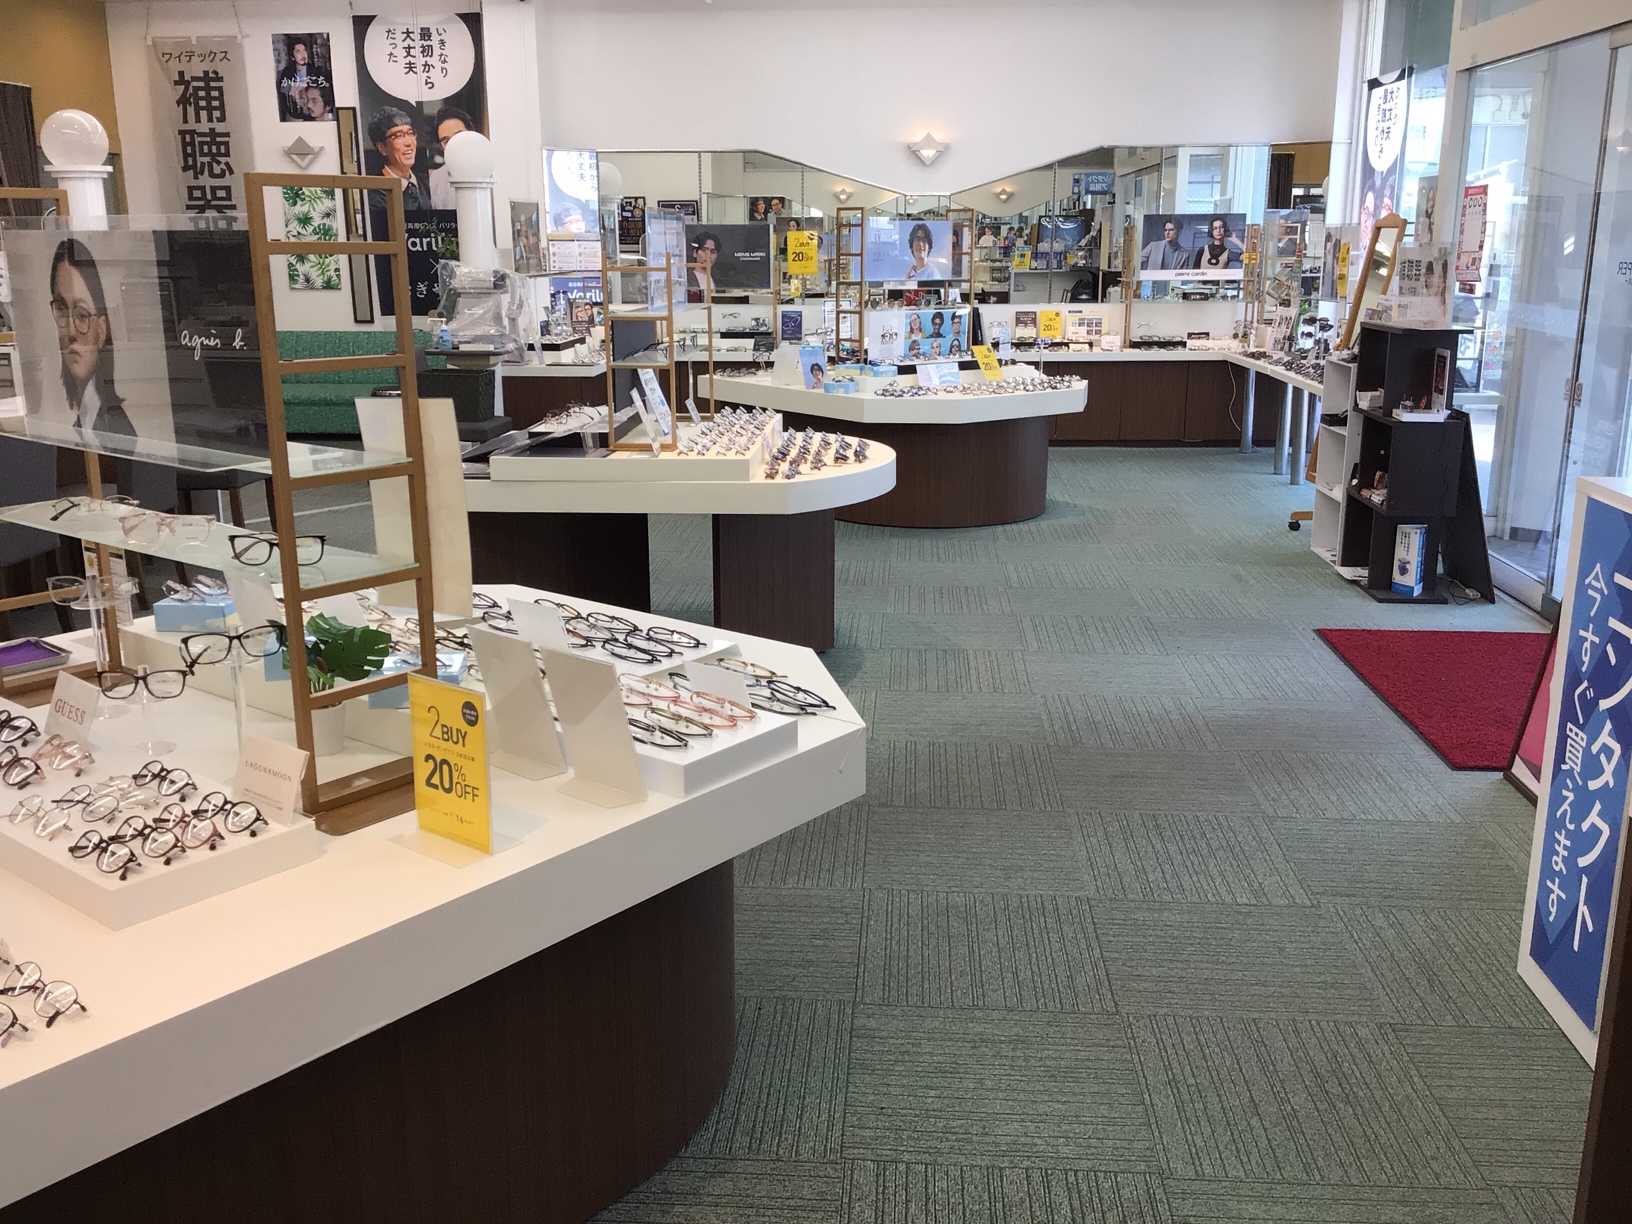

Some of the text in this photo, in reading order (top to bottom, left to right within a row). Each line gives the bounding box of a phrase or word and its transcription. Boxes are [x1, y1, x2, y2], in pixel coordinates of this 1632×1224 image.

[161, 50, 231, 64] ワイデックス
[385, 27, 399, 64] だった
[401, 27, 418, 75] 大丈夫
[419, 26, 436, 90] 最初から
[436, 27, 449, 79] いきなり
[173, 69, 239, 230] 補聴器
[180, 328, 247, 361] agnès b.
[54, 698, 86, 726] GUESS
[1545, 562, 1609, 923] 今すぐ買えます
[454, 781, 480, 803] OFF
